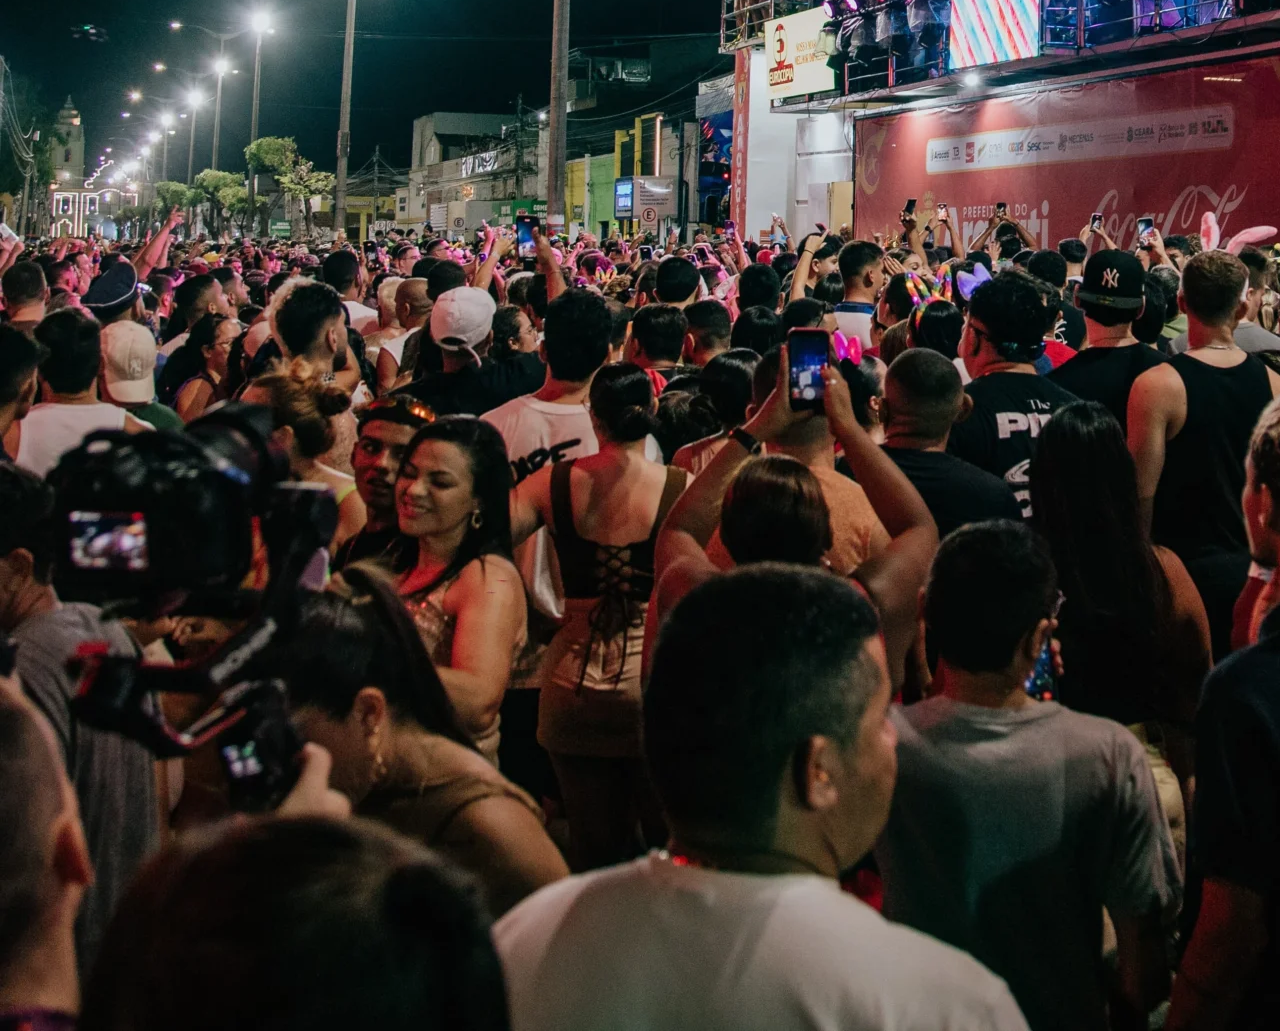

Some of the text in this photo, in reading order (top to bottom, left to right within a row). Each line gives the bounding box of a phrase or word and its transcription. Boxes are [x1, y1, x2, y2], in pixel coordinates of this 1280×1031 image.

[646, 211, 652, 219] E
[963, 203, 1028, 218] PREFEIT DO
[1102, 268, 1120, 288] NY
[1027, 398, 1051, 410] The
